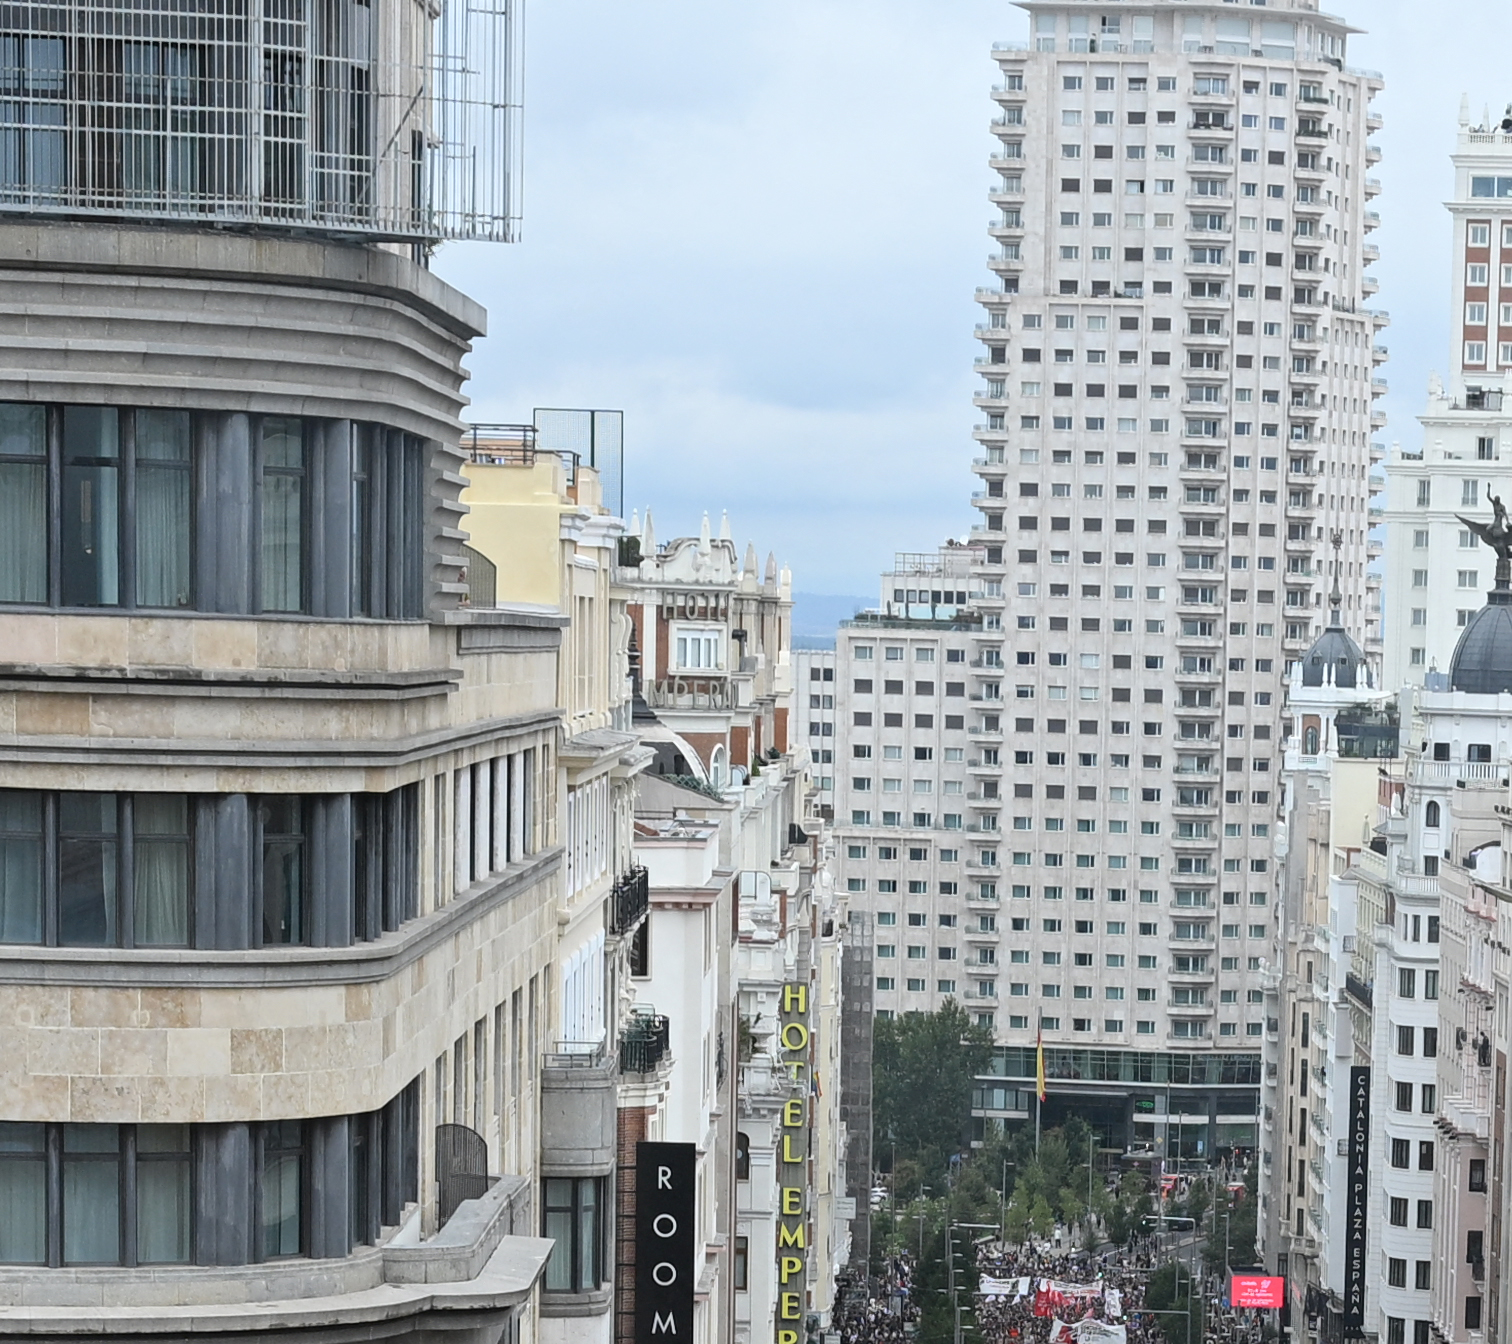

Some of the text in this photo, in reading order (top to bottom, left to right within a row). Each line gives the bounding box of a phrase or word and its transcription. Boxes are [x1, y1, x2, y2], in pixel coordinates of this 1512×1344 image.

[781, 985, 808, 1162] HOTEL
[651, 1165, 677, 1335] ROOM
[1350, 1075, 1366, 1315] CATALONIA PLAZA ESPAÑA
